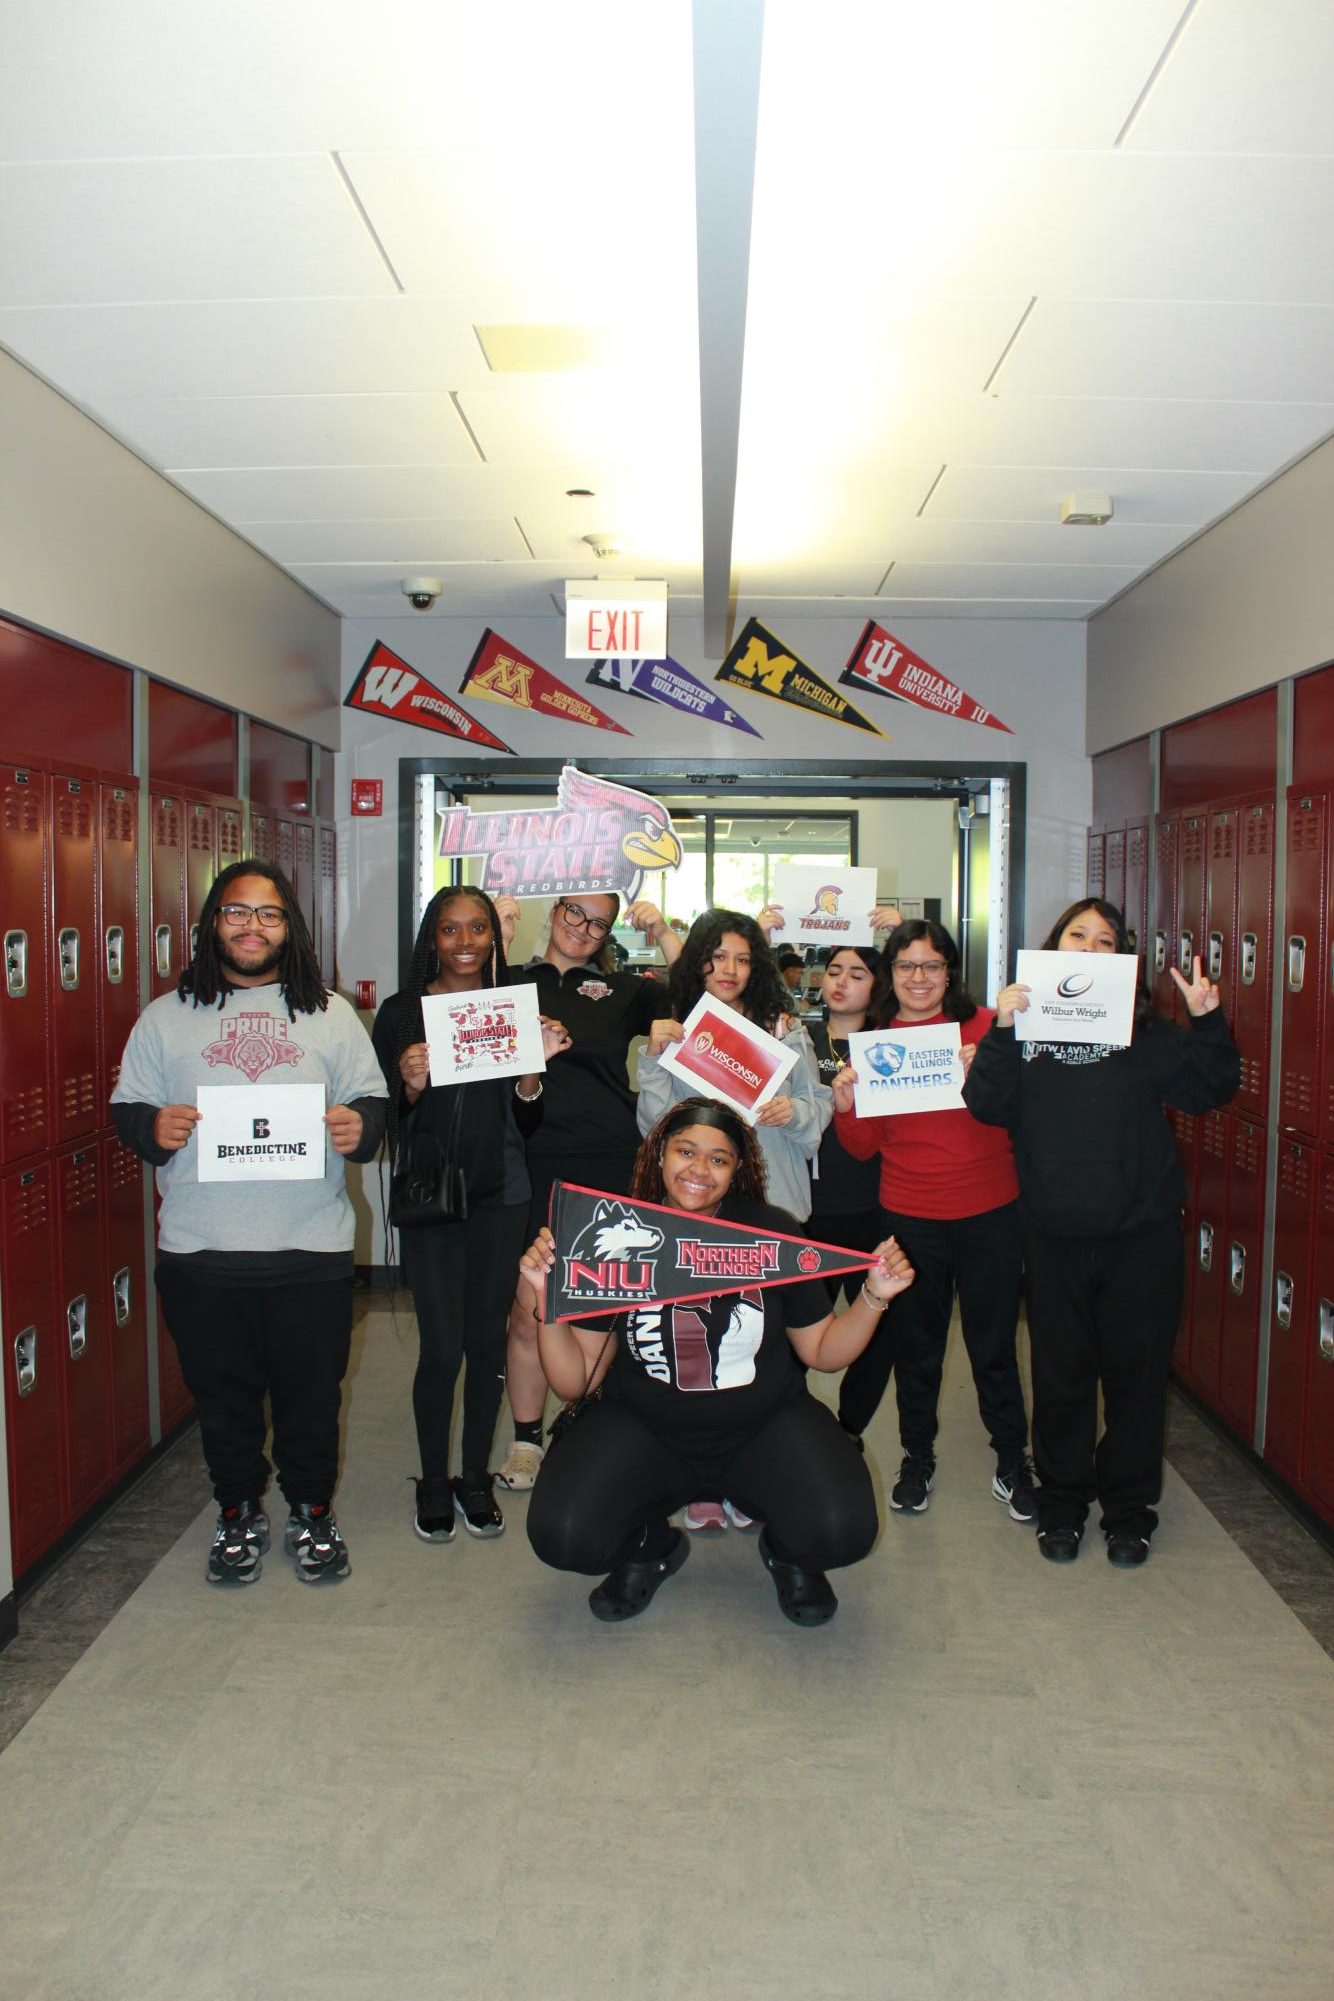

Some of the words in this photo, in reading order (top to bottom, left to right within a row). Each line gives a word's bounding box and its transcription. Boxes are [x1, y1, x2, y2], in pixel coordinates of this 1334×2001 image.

[587, 610, 644, 651] EXIT
[733, 636, 797, 695] M
[362, 666, 420, 709] W
[474, 654, 534, 708] M
[651, 664, 717, 705] NORTHWESTERN
[651, 676, 707, 713] WILDCATS
[790, 673, 847, 713] MICHIGAN
[902, 663, 964, 706] INDIANA
[898, 677, 960, 715] UNIVERSITY
[410, 694, 472, 736] WISCONSIN
[970, 706, 989, 724] IU
[441, 808, 624, 853] ILLINOIS
[487, 843, 615, 888] STATE
[516, 878, 614, 893] REDBIRDS
[799, 917, 851, 931] TROJANS
[1041, 1005, 1074, 1016] Wilbur
[1075, 1007, 1108, 1019] Wright
[221, 1017, 287, 1040] PRIDE
[709, 1045, 763, 1087] WISCONSIN
[908, 1048, 953, 1061] EASTERN
[912, 1057, 952, 1069] ILLINOIS
[1061, 1052, 1102, 1061] ACADEMY
[869, 1072, 953, 1092] PANTHERS
[252, 1118, 270, 1139] B
[217, 1142, 307, 1159] BENEDICTINE
[229, 1155, 296, 1164] COLLEGE
[679, 1240, 776, 1267] NORTHERN
[568, 1260, 650, 1289] NIU
[695, 1261, 761, 1276] ILLINOIS
[574, 1290, 644, 1298] HUSKIES
